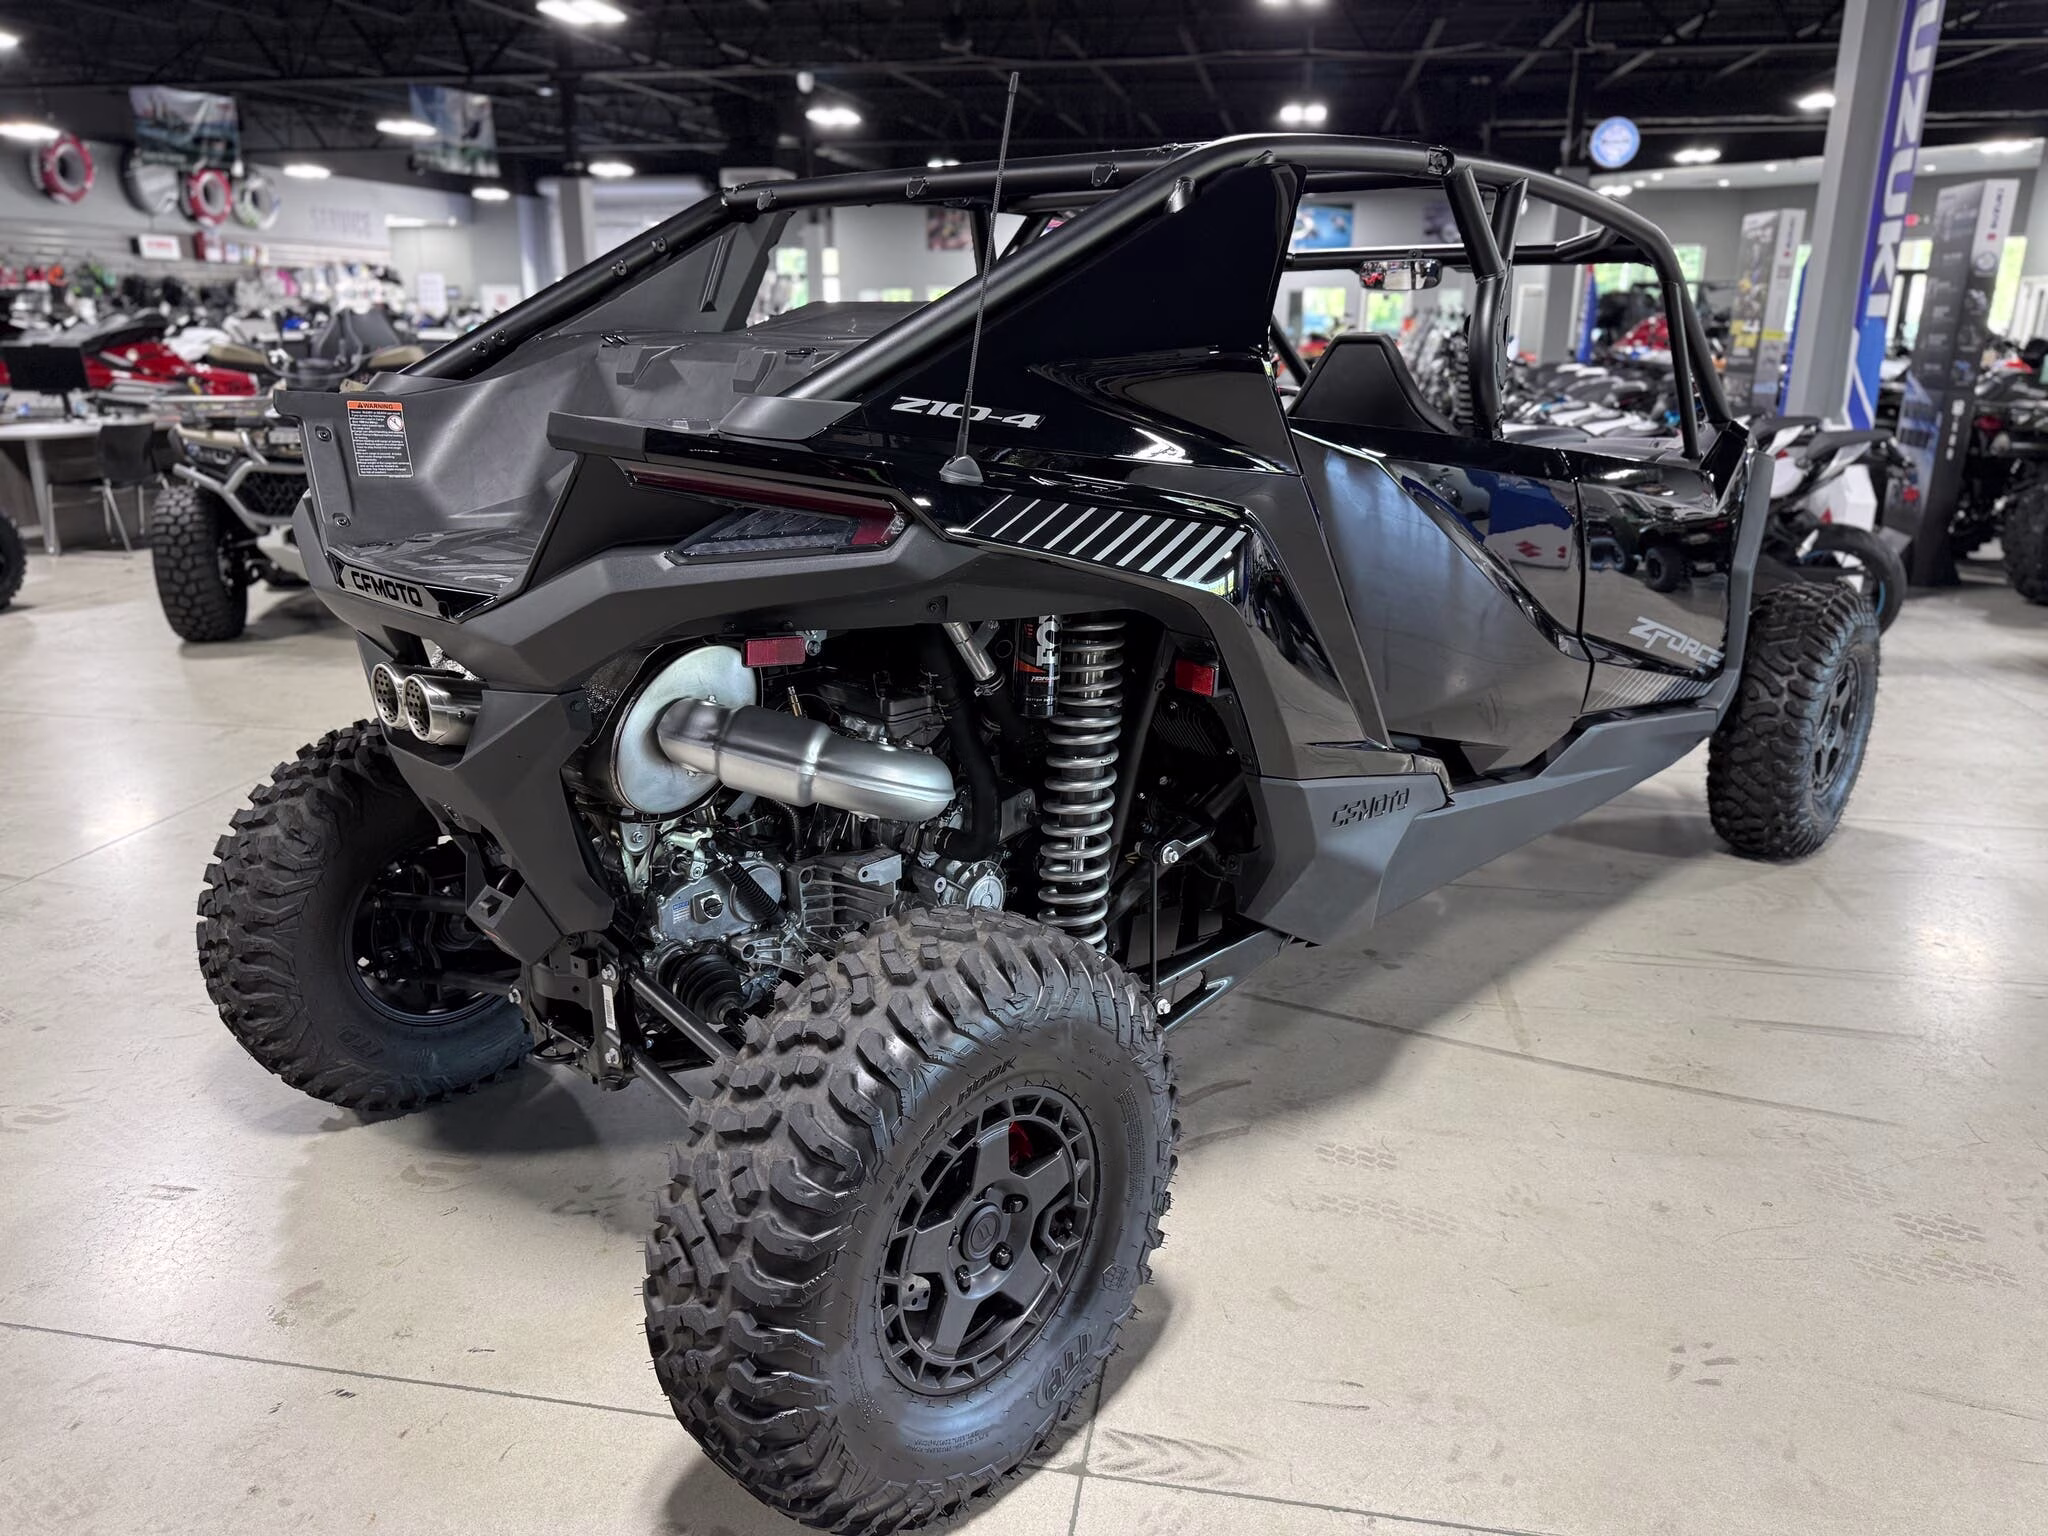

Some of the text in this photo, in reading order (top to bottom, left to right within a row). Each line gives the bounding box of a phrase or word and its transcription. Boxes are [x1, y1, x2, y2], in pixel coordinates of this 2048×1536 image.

[1864, 0, 1940, 318] UZUKI
[891, 396, 1041, 429] Z10-4
[351, 570, 423, 607] CFMOTO
[1331, 787, 1409, 829] CFMOTO
[957, 1055, 1018, 1107] HOOK
[1045, 1332, 1089, 1402] ITP
